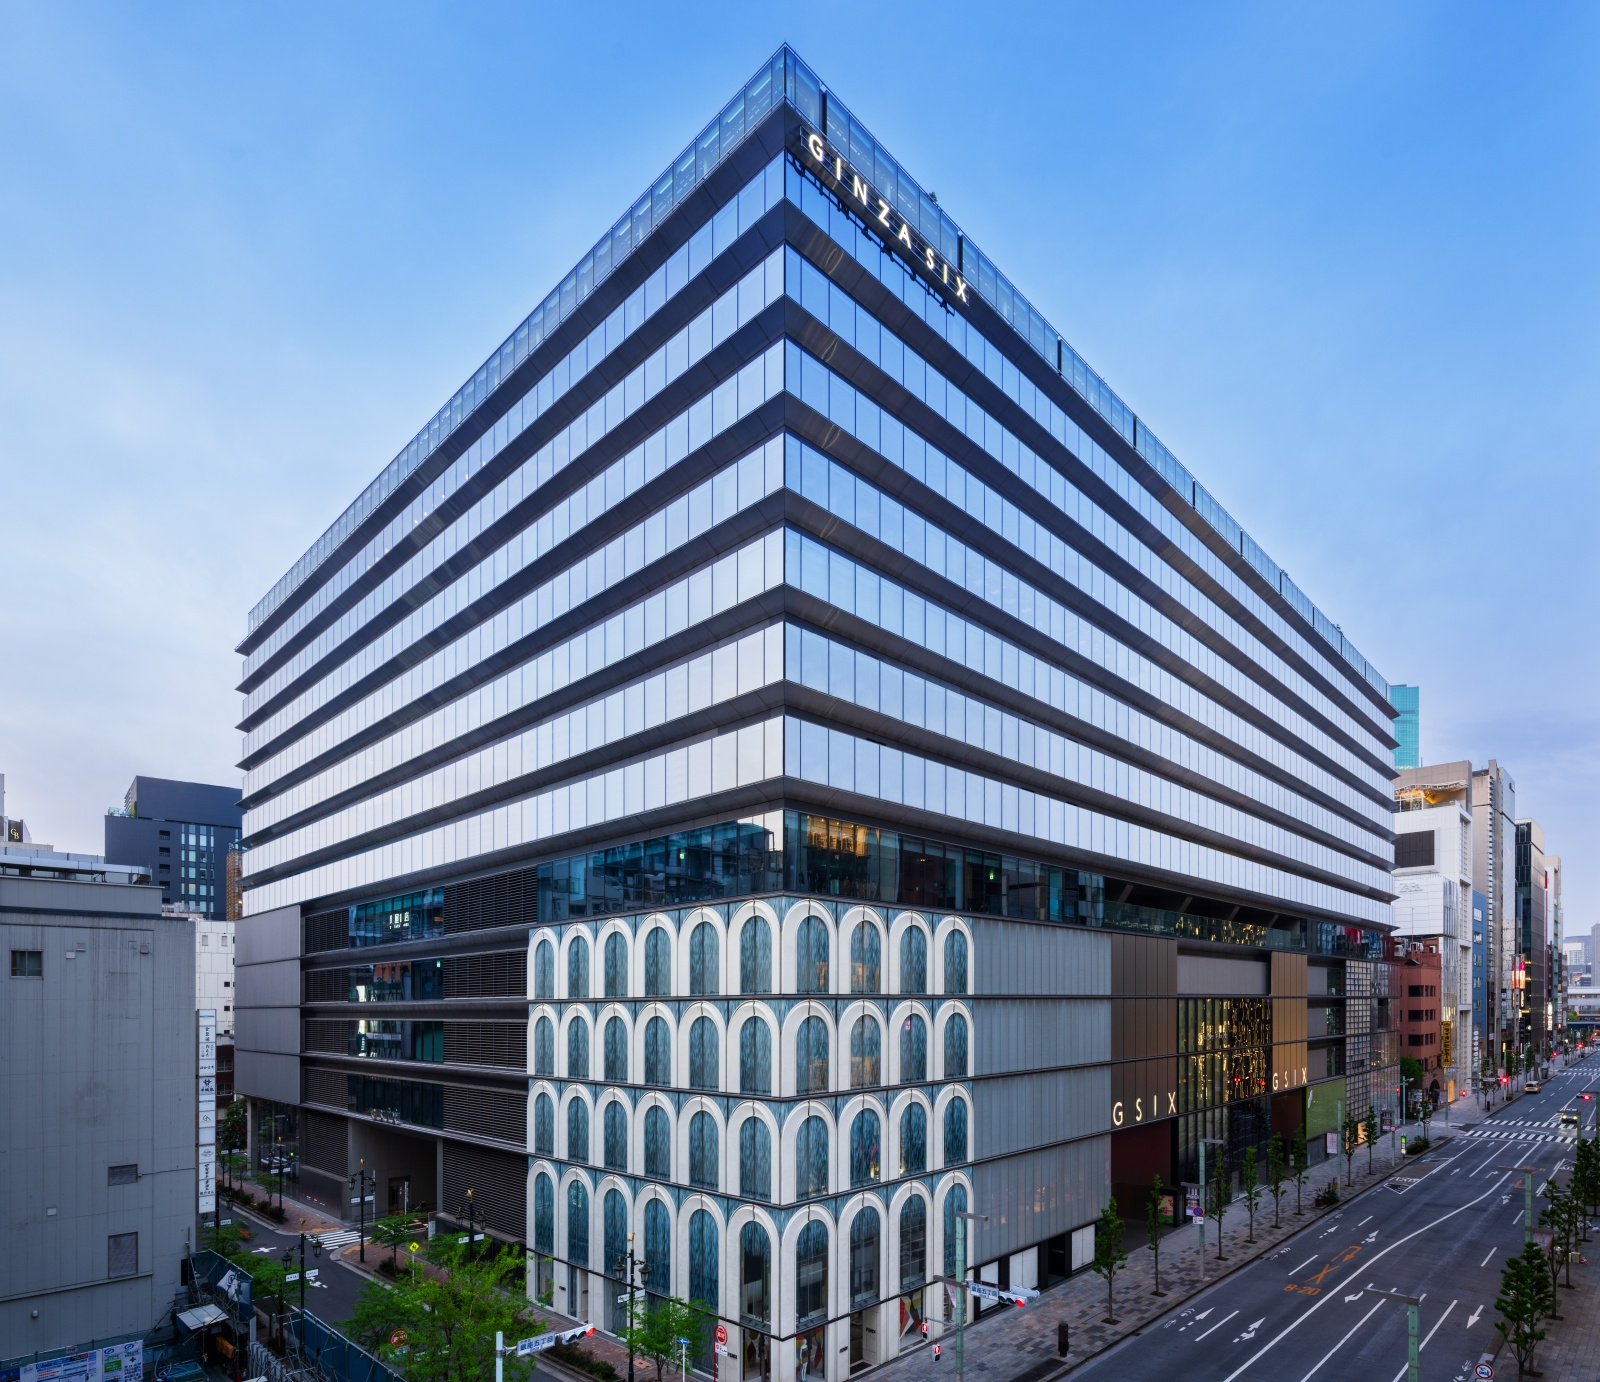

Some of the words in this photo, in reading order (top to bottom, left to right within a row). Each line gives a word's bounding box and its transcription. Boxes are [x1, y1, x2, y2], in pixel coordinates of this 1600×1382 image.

[808, 133, 912, 250] GINZA
[925, 248, 968, 304] SIX
[1283, 1283, 1322, 1296] 8-20
